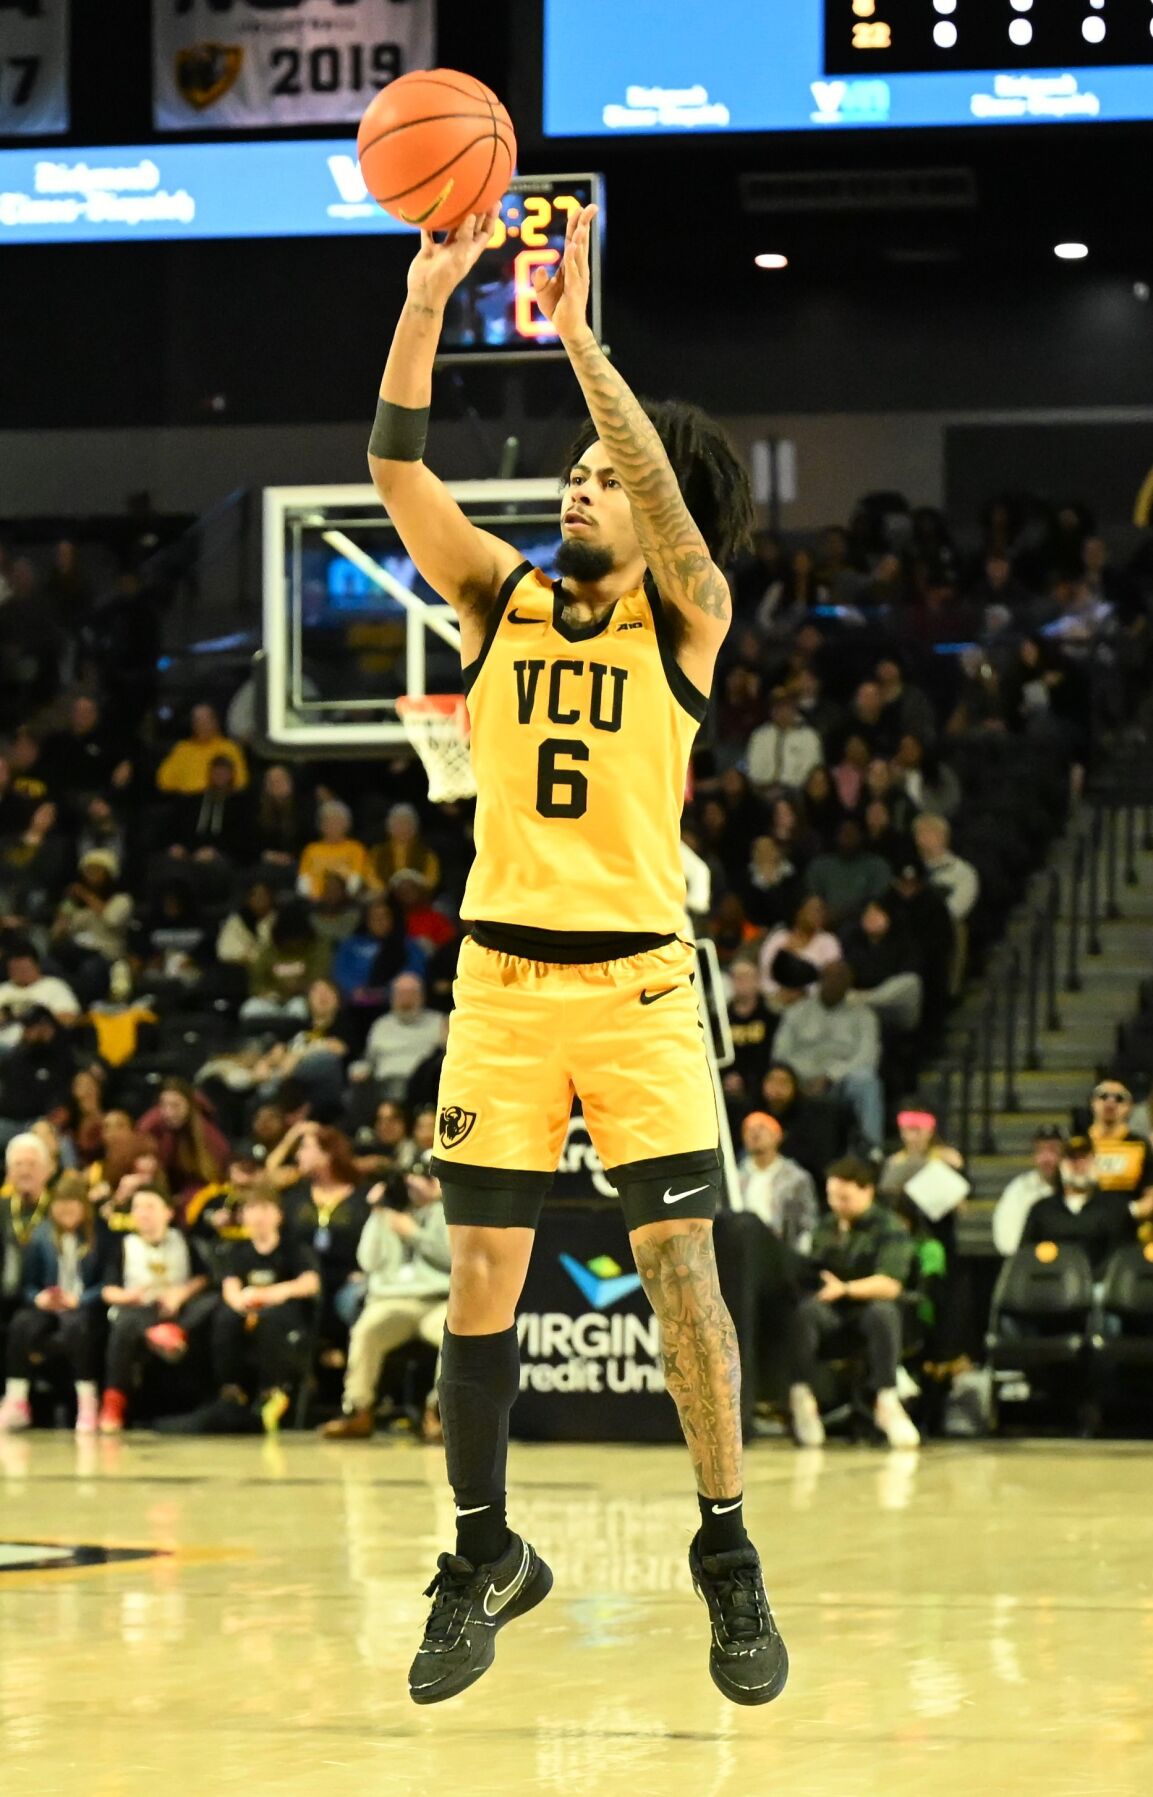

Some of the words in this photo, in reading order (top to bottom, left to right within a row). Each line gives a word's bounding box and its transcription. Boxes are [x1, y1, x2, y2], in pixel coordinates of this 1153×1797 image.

[270, 43, 402, 95] 2019
[513, 660, 629, 733] VCU
[536, 738, 590, 819] 6
